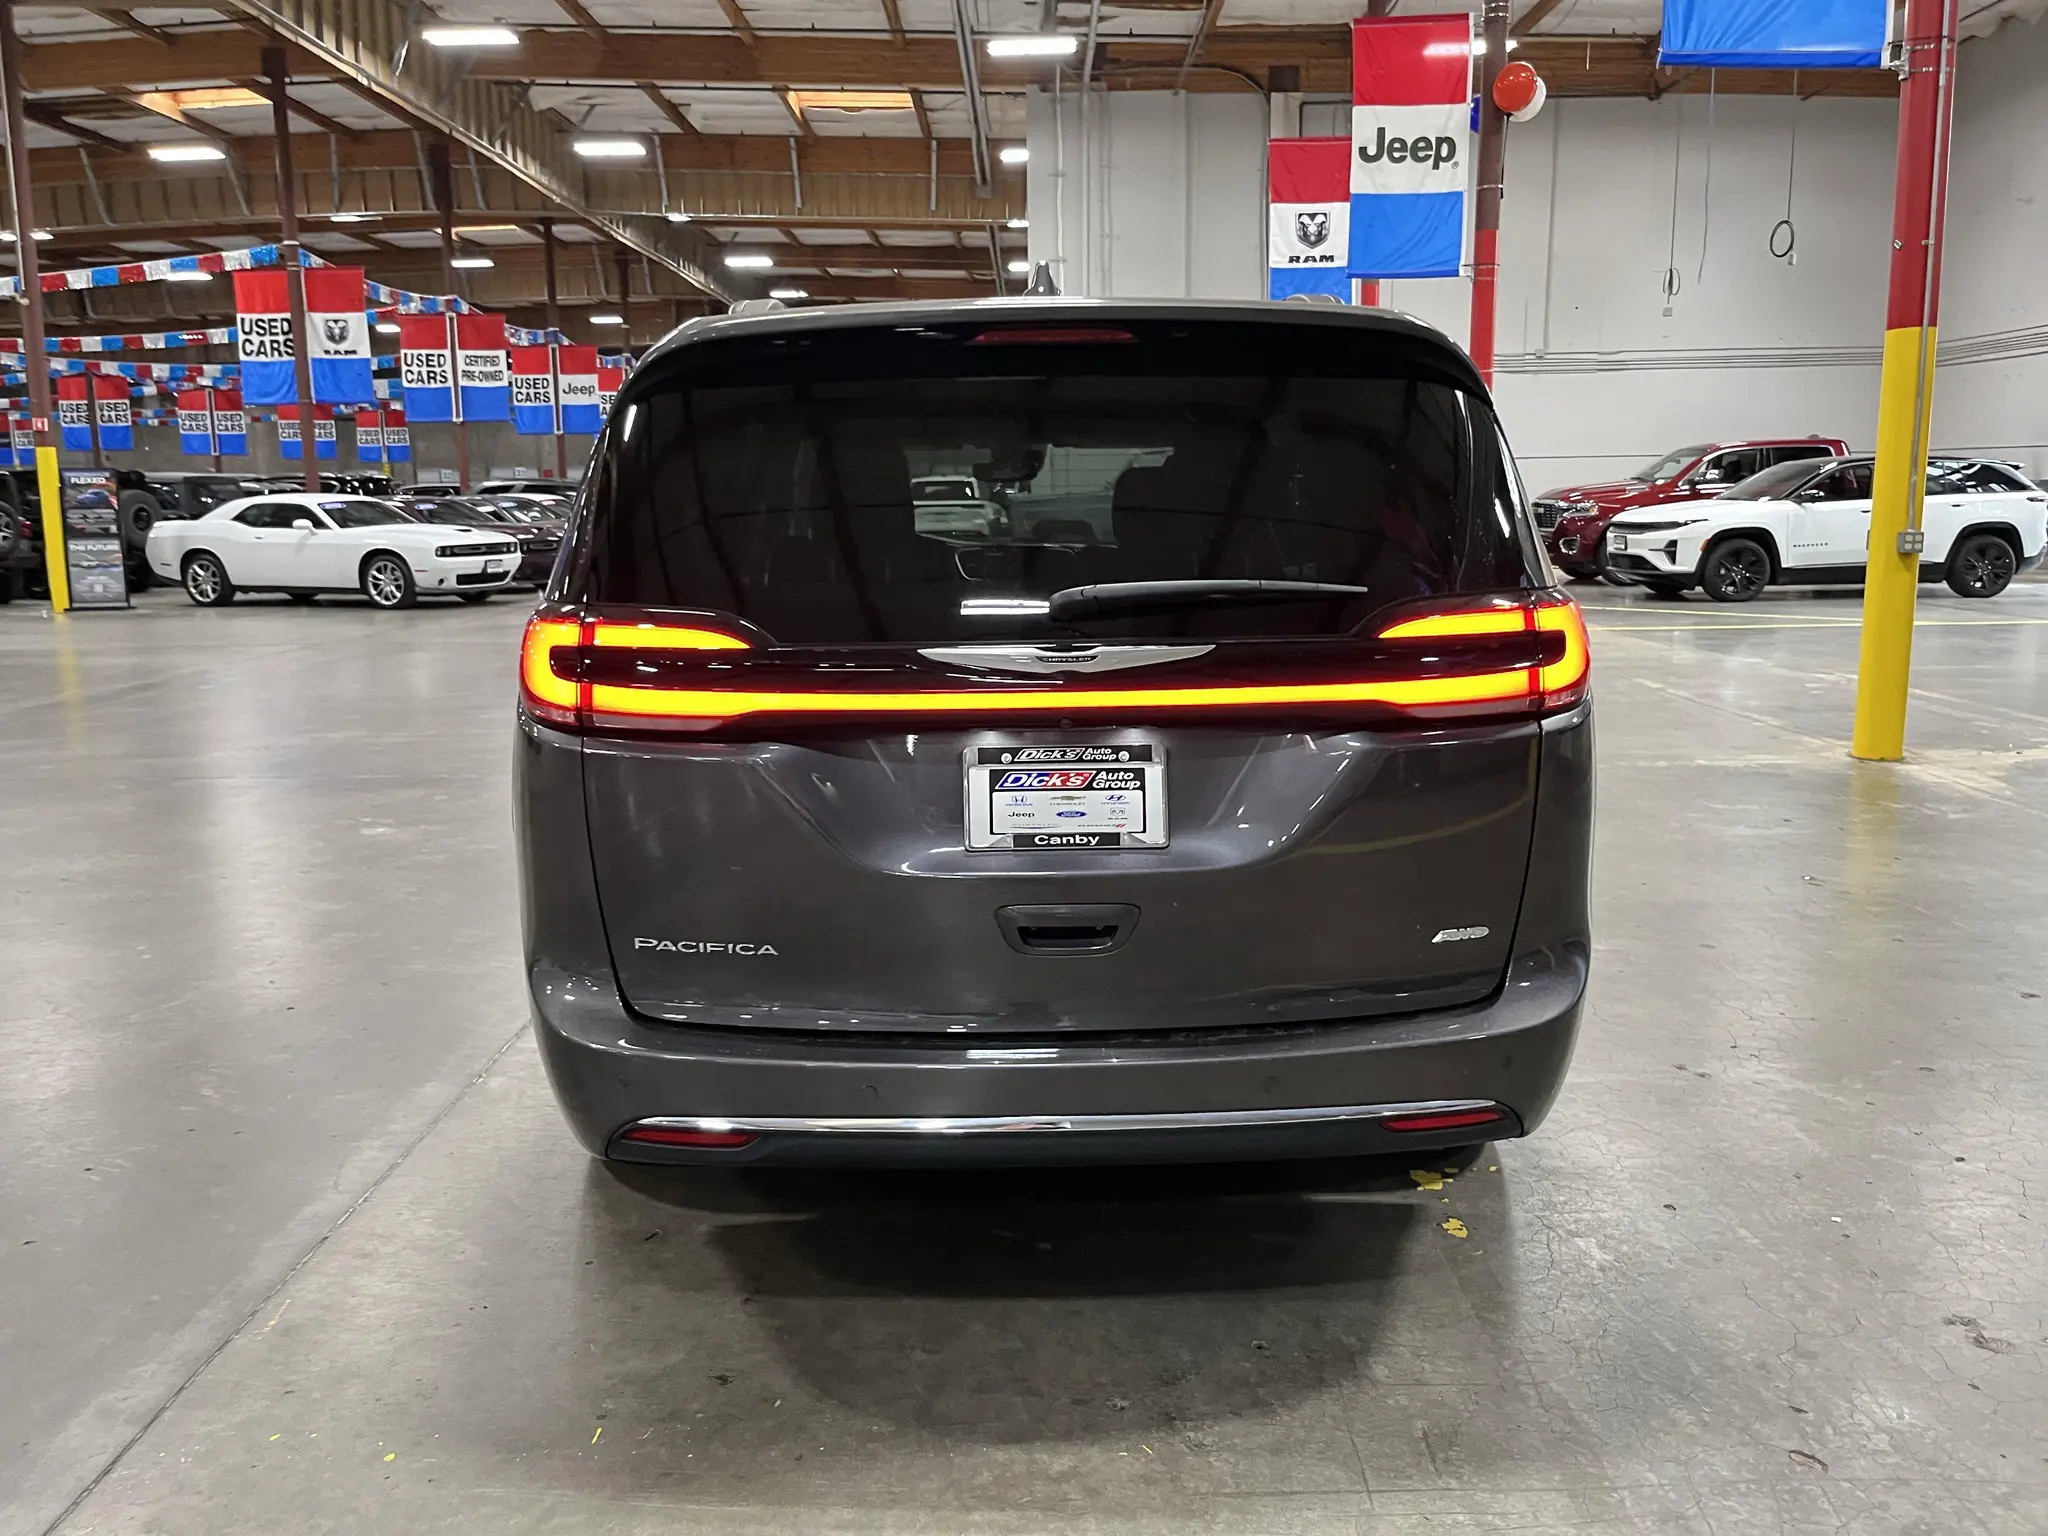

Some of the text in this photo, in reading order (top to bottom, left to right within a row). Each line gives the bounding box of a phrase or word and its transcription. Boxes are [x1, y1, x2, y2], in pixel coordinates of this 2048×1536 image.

[1358, 127, 1457, 170] Jeep
[1288, 255, 1335, 264] RAM
[240, 317, 292, 337] USED
[242, 338, 294, 358] CARS
[403, 352, 447, 368] USED
[464, 354, 501, 367] CERTIFIED
[404, 369, 449, 385] CARS
[461, 369, 504, 382] PRE-OWNED
[515, 377, 550, 390] USED
[562, 382, 596, 397] Jeep
[515, 391, 551, 404] CARS
[601, 394, 615, 405] SE
[98, 402, 129, 413] USED
[100, 413, 130, 424] CARS
[180, 413, 208, 423] USED
[216, 413, 243, 423] USED
[181, 423, 209, 433] CARS
[216, 423, 244, 433] CARS
[315, 421, 334, 431] SED
[315, 431, 335, 440] ARS
[358, 429, 380, 437] USED
[385, 429, 407, 437] USED
[359, 437, 381, 445] CARS
[386, 437, 409, 445] CARS
[1019, 747, 1112, 759] Dick's Auto
[1082, 753, 1117, 761] Group
[1003, 771, 1135, 787] Dick's Auto
[1092, 780, 1141, 790] Group
[1034, 834, 1100, 846] Canby
[634, 937, 779, 956] PACIFICA
